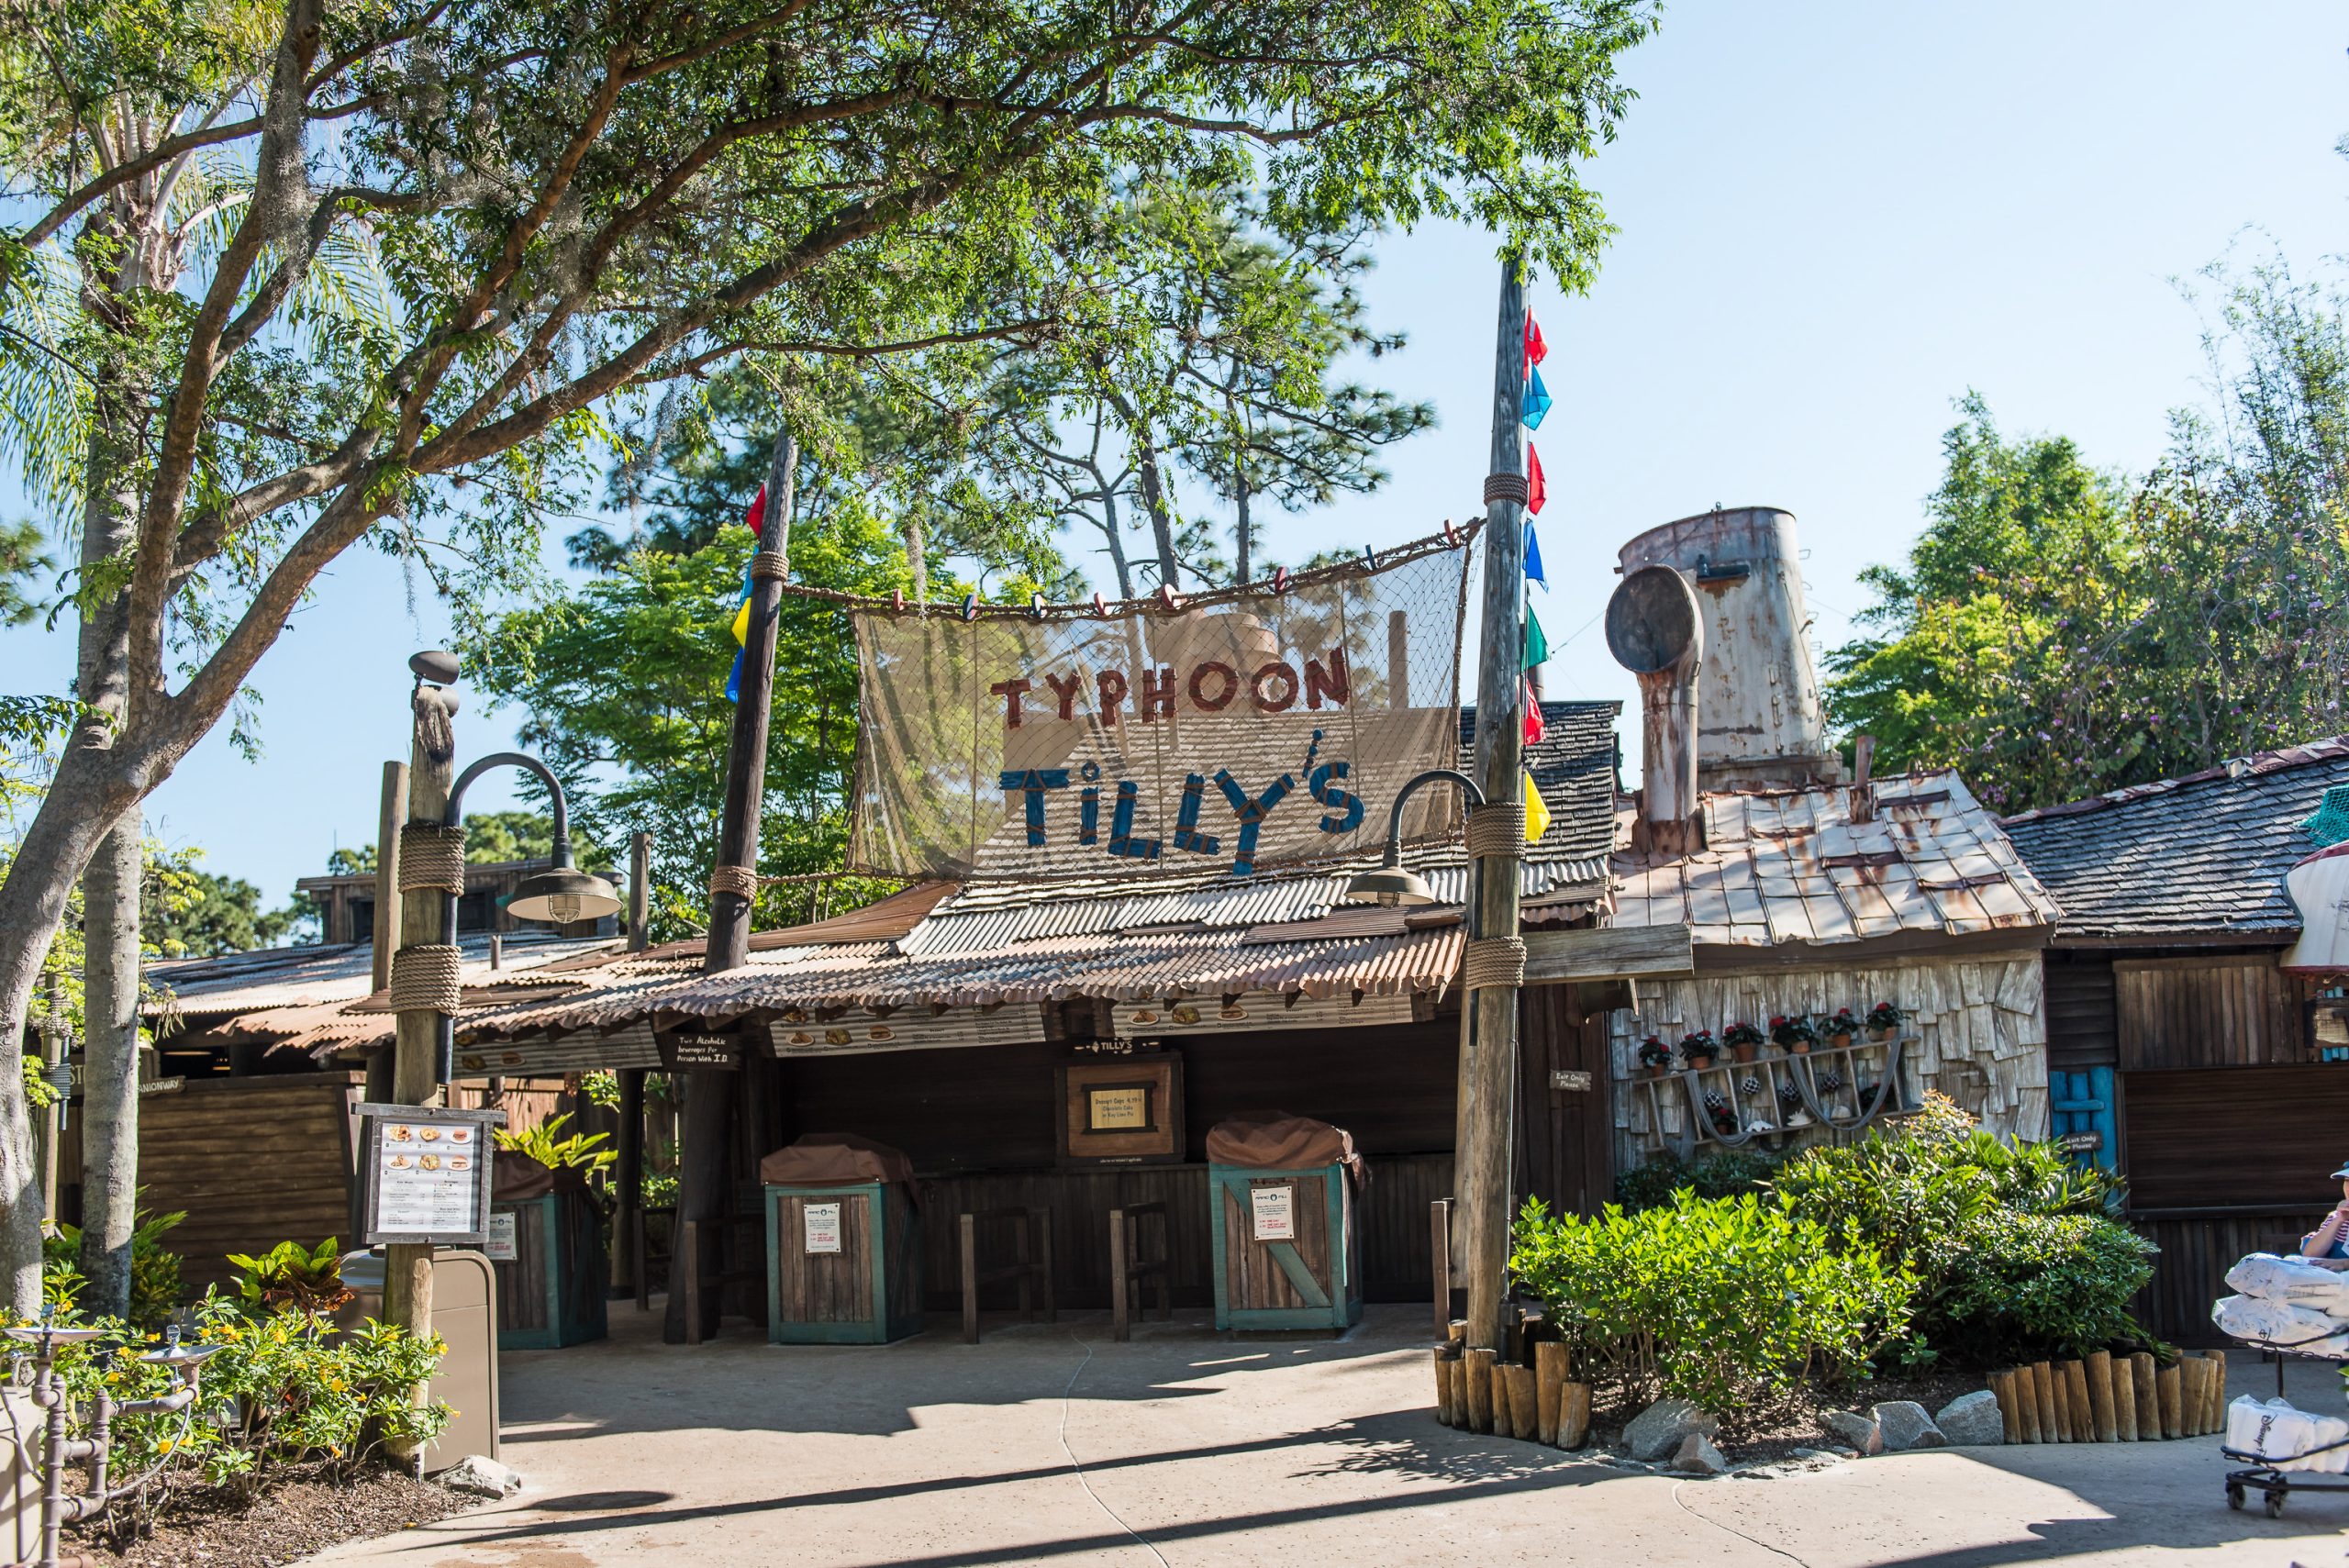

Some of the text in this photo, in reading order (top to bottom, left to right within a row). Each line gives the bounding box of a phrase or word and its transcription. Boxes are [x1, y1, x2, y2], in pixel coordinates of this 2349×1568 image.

[991, 646, 1350, 729] TYPHOON
[679, 1036, 693, 1044] Two
[1101, 1040, 1133, 1051] TILLY'S
[1570, 1073, 1586, 1083] Only
[139, 1079, 179, 1093] ANIONWAY
[1560, 1080, 1579, 1088] Please
[2254, 1414, 2278, 1447] Disney
